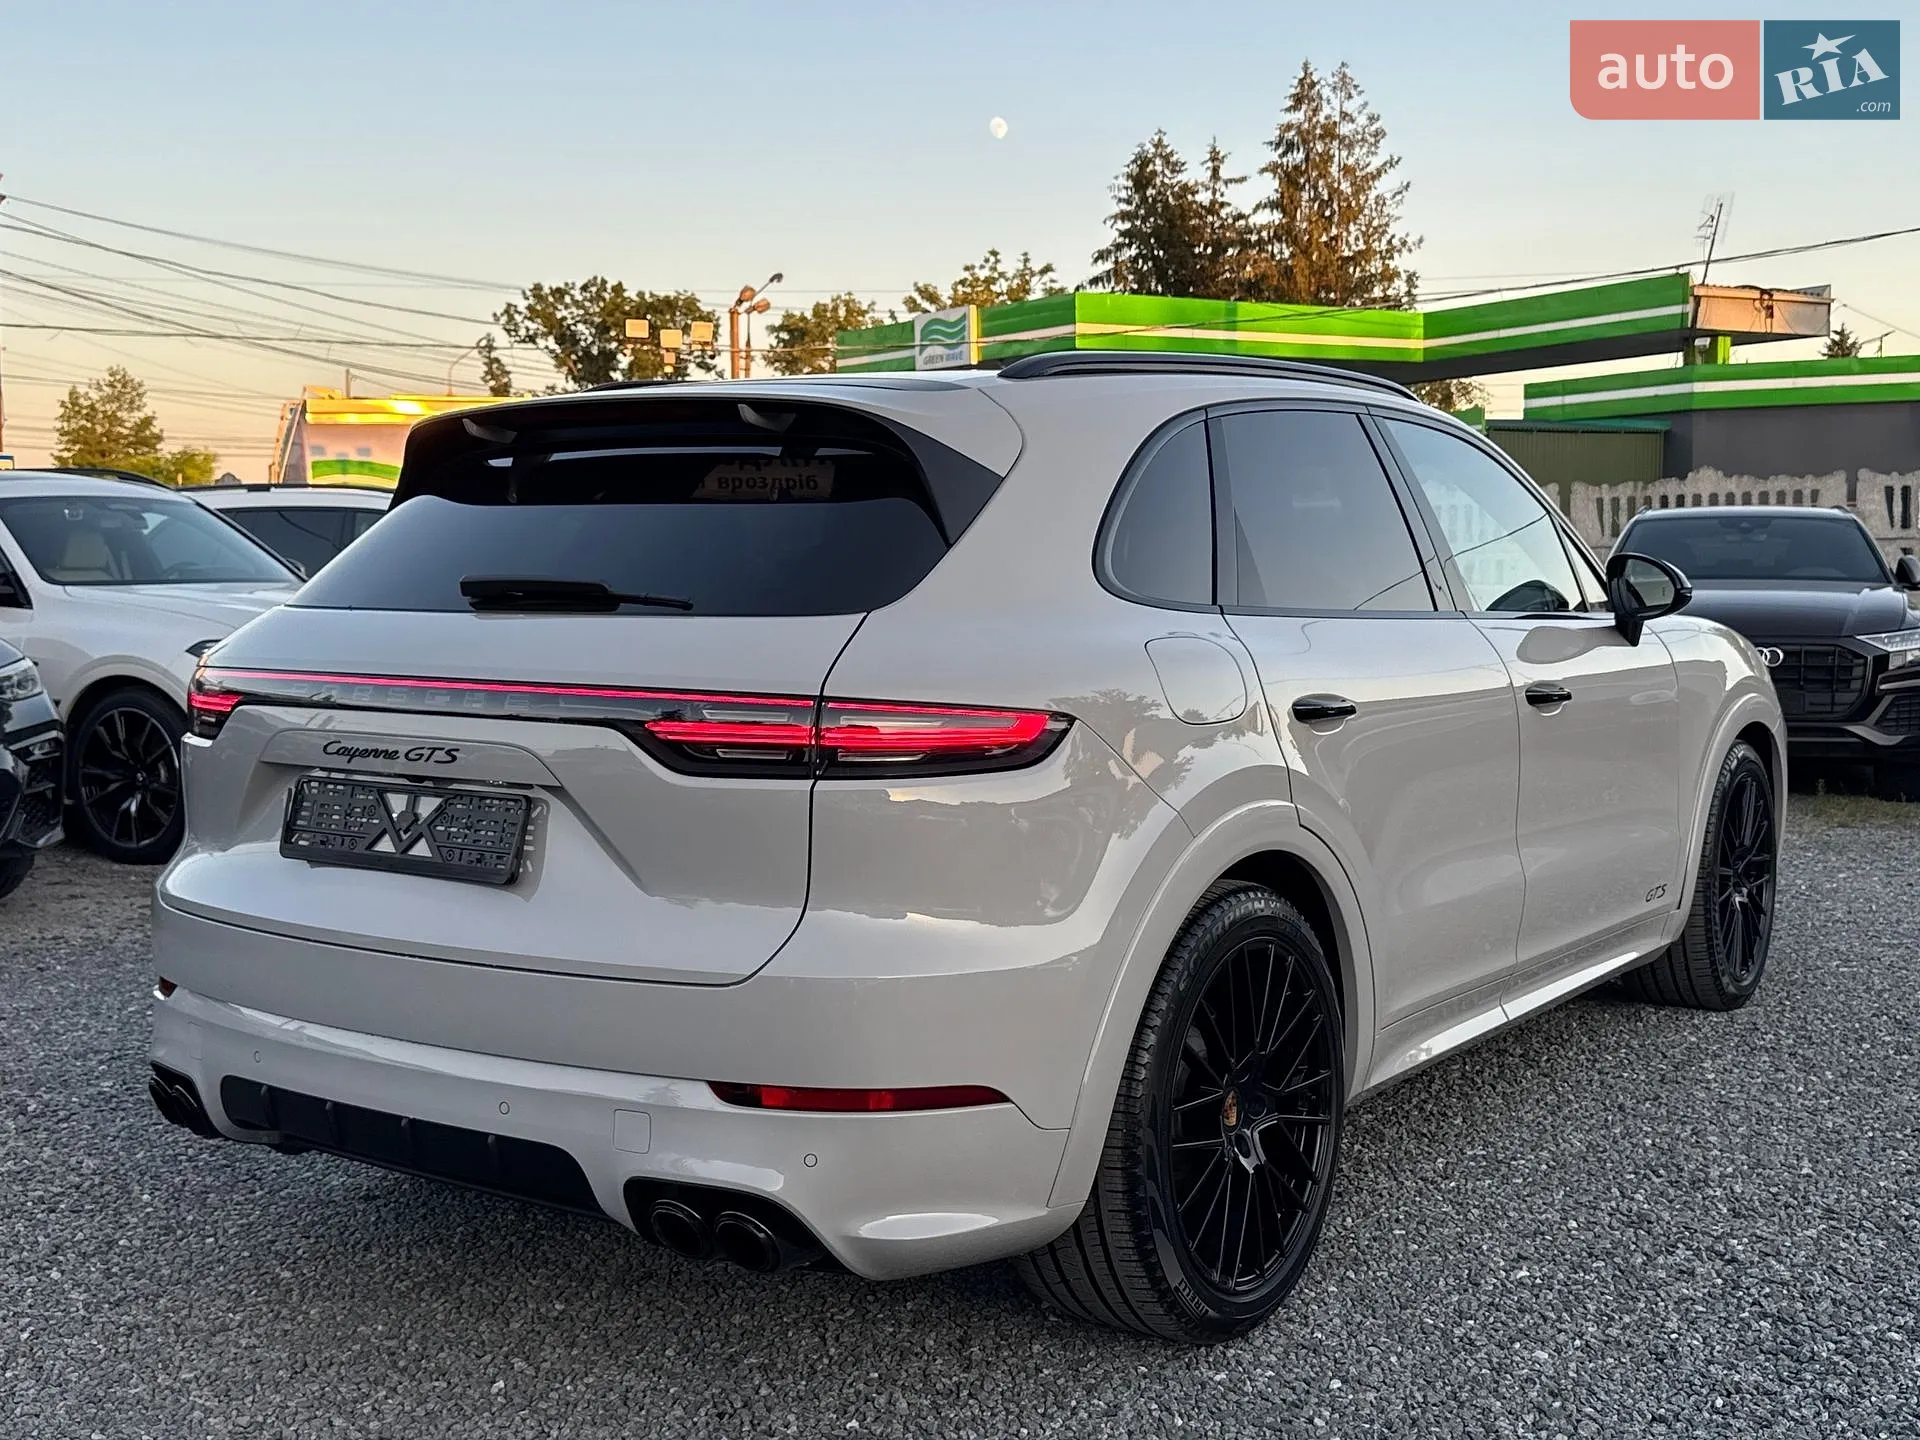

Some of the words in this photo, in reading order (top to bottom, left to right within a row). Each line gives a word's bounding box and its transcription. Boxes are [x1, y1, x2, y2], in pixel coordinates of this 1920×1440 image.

[322, 740, 401, 764] Cayenne
[403, 746, 460, 764] GTS
[1645, 883, 1668, 903] GTS
